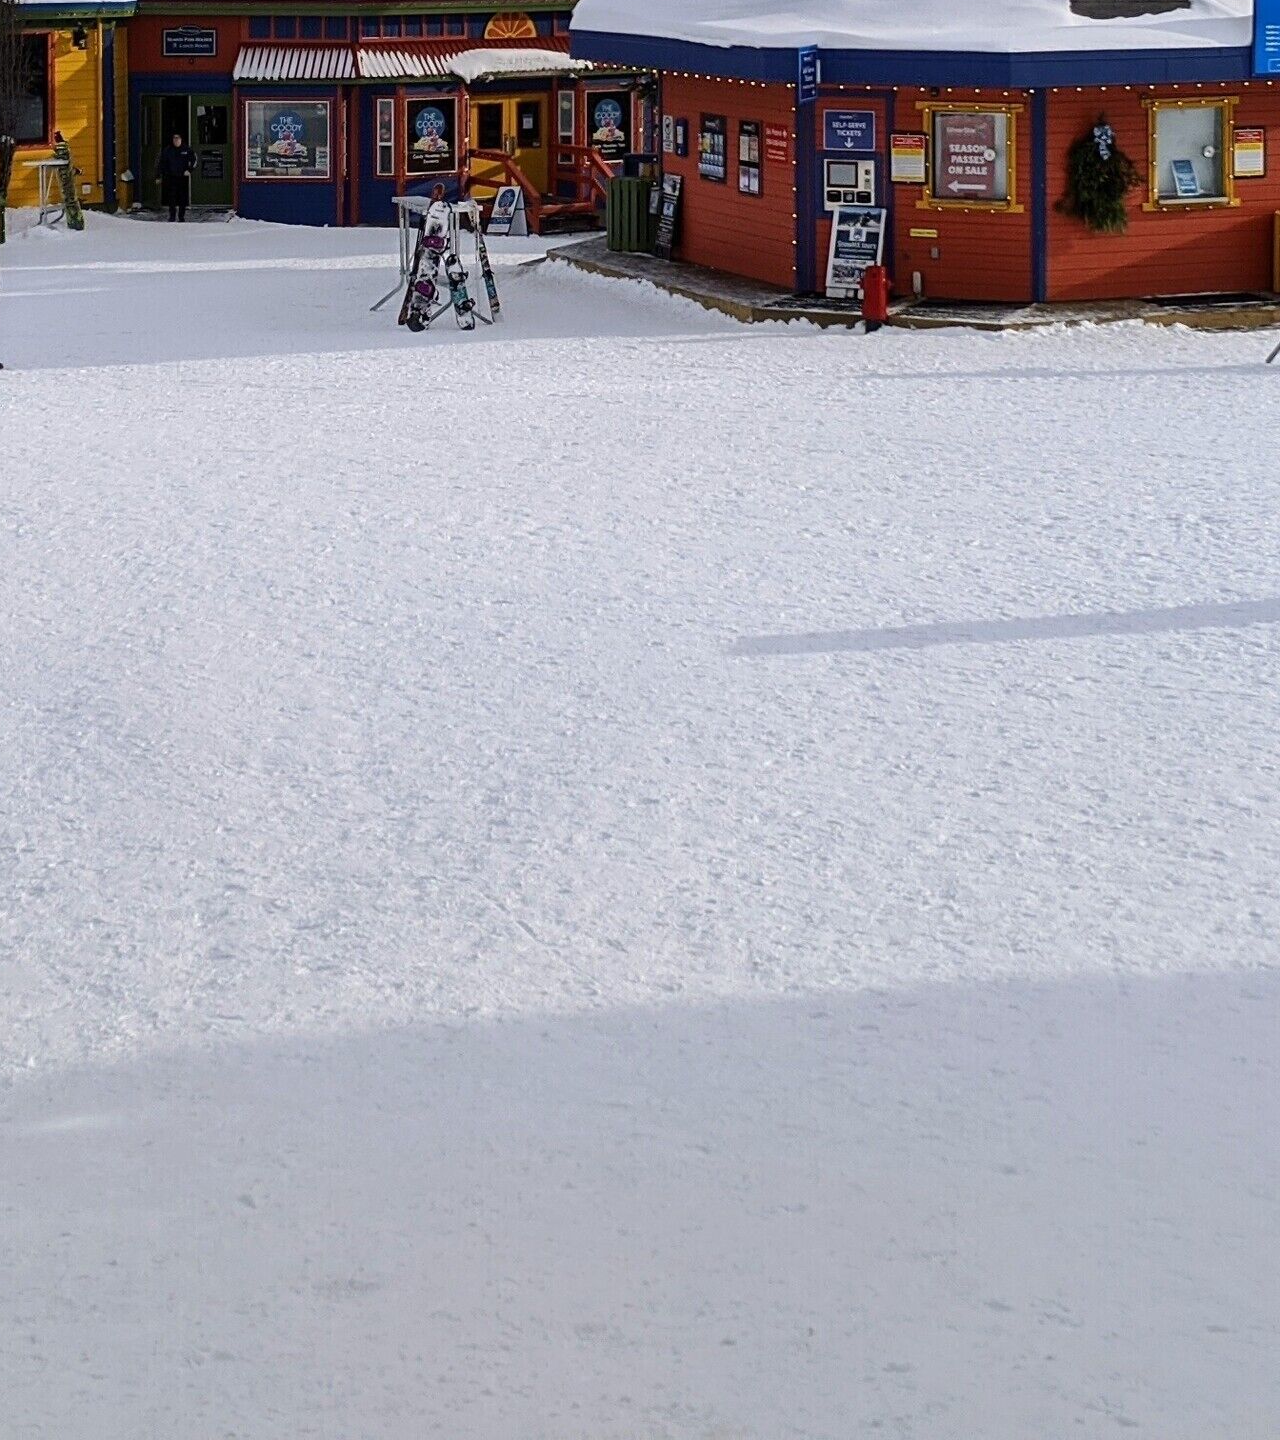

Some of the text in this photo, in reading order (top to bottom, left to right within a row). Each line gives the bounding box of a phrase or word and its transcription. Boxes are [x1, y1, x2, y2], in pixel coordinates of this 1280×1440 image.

[279, 115, 294, 124] THE
[423, 112, 437, 121] THE
[836, 129, 862, 137] TICKETS
[948, 144, 988, 154] SEASON
[950, 155, 986, 164] PASSES
[948, 165, 988, 176] ON SALE
